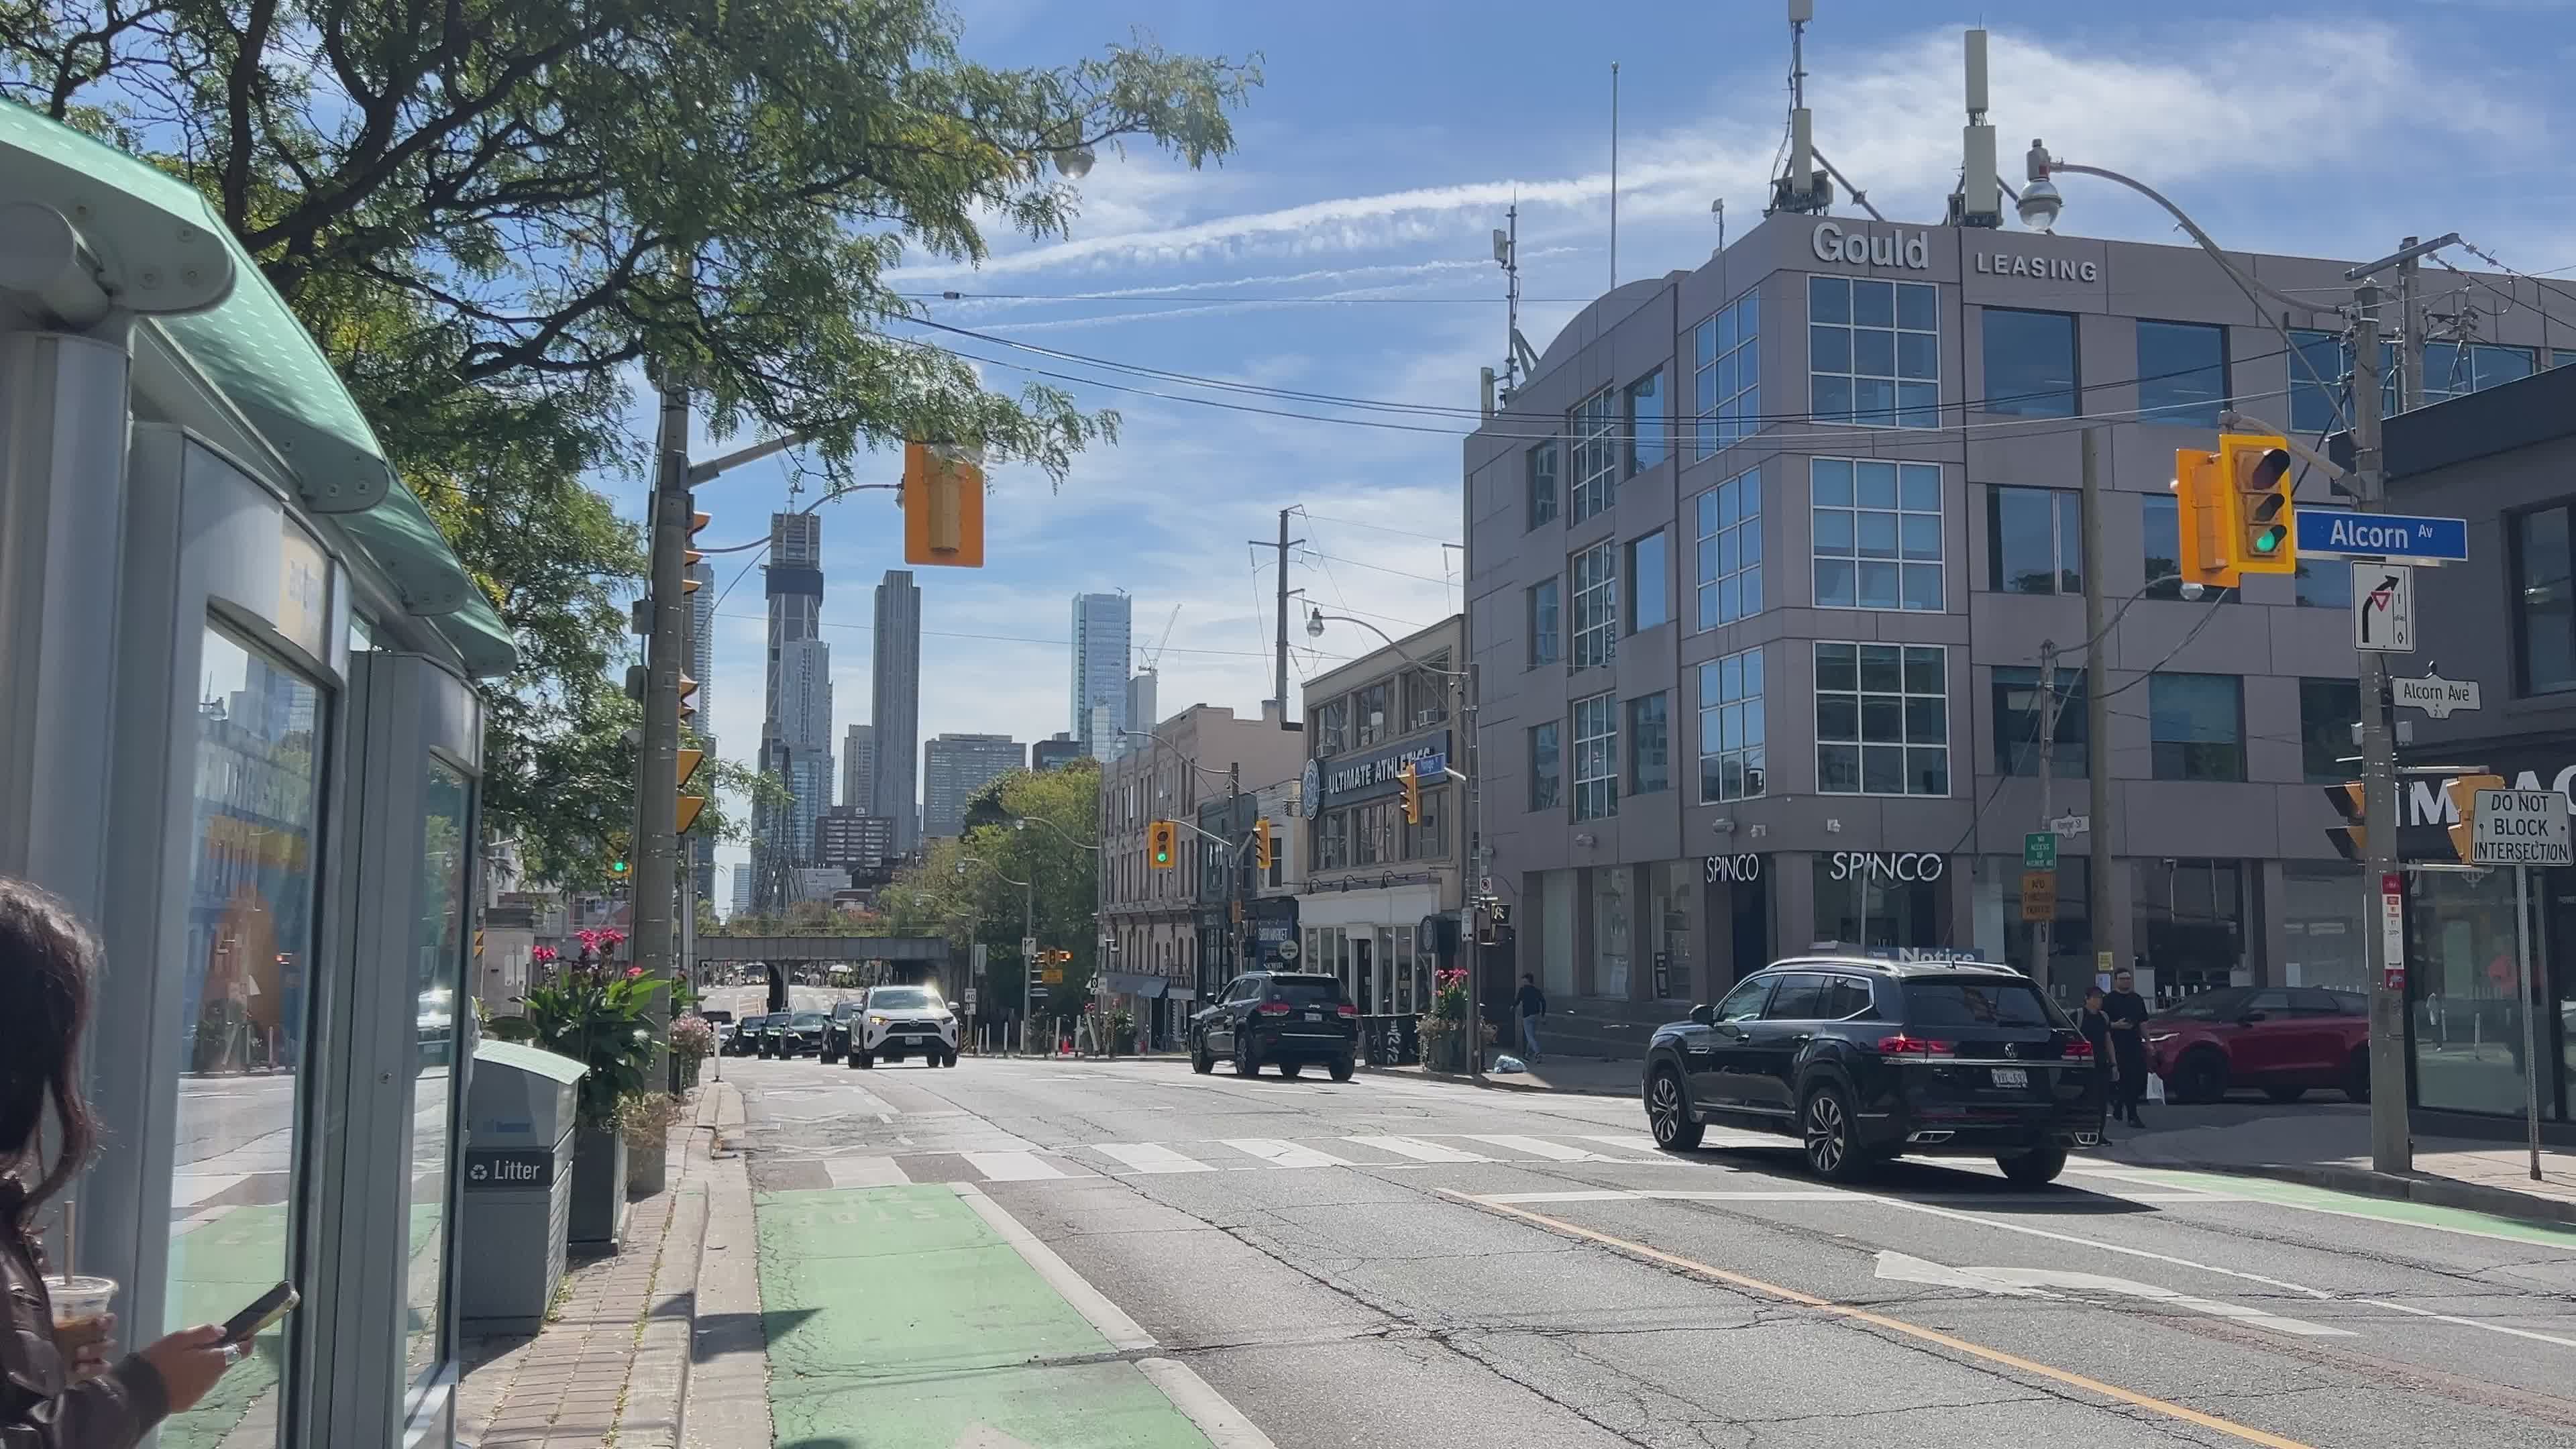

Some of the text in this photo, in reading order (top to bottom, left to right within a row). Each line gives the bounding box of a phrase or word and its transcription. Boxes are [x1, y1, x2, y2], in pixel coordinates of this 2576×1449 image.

[1812, 222, 1929, 269] Gould
[1977, 252, 2098, 282] LEASING
[2330, 519, 2408, 549] Alcorn
[2404, 682, 2469, 701] Alcorn Ave
[1328, 763, 1372, 795] ULTIMATE
[2491, 794, 2549, 812] DO NOT
[2494, 818, 2549, 837] BLOCK
[2474, 842, 2569, 861] INTERSECTION
[1706, 853, 1759, 883] SPINCO
[1898, 947, 1975, 962] Notice
[494, 1160, 541, 1181] Litter
